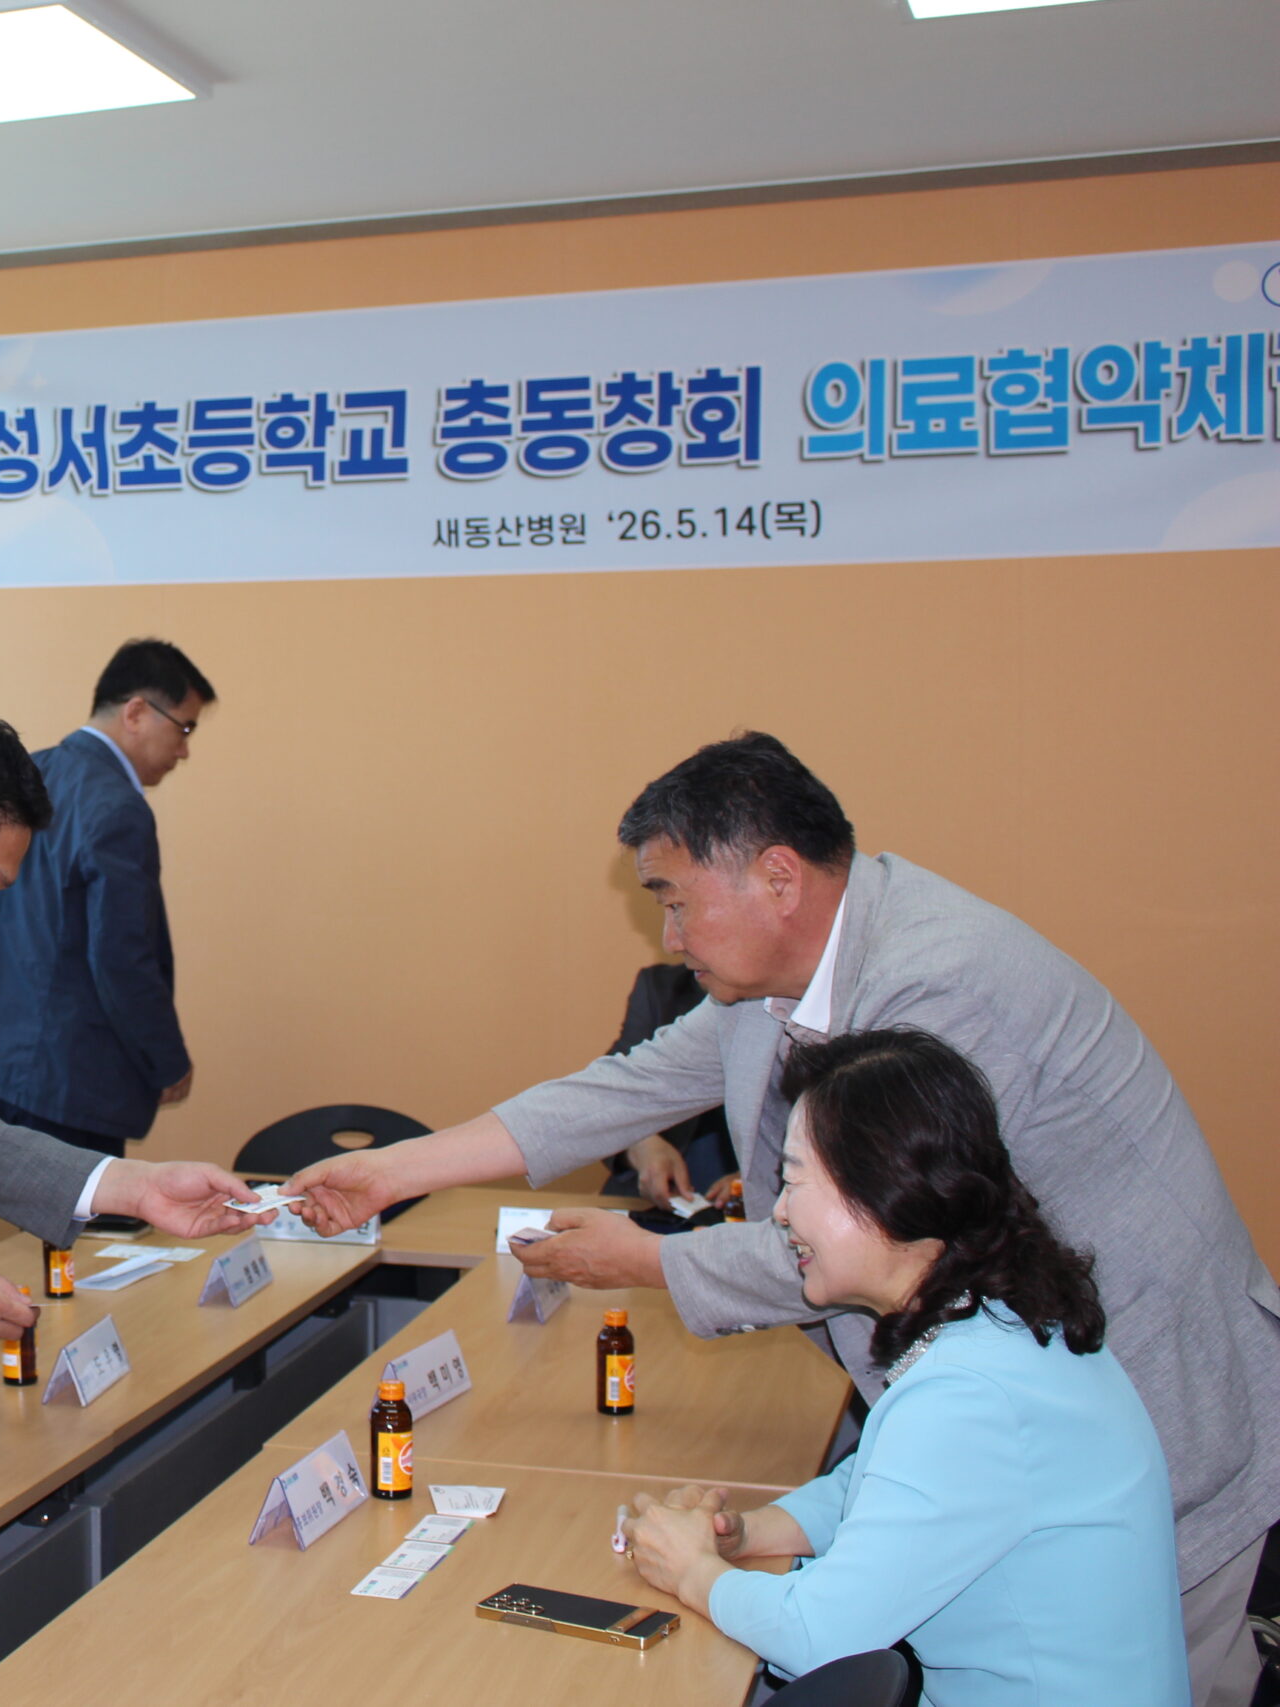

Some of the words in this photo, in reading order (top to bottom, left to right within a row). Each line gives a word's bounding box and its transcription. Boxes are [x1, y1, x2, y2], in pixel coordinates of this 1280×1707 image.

[437, 365, 763, 477] 총동창회
[804, 331, 1280, 457] 의료협약체
[432, 512, 587, 549] 새동산병원
